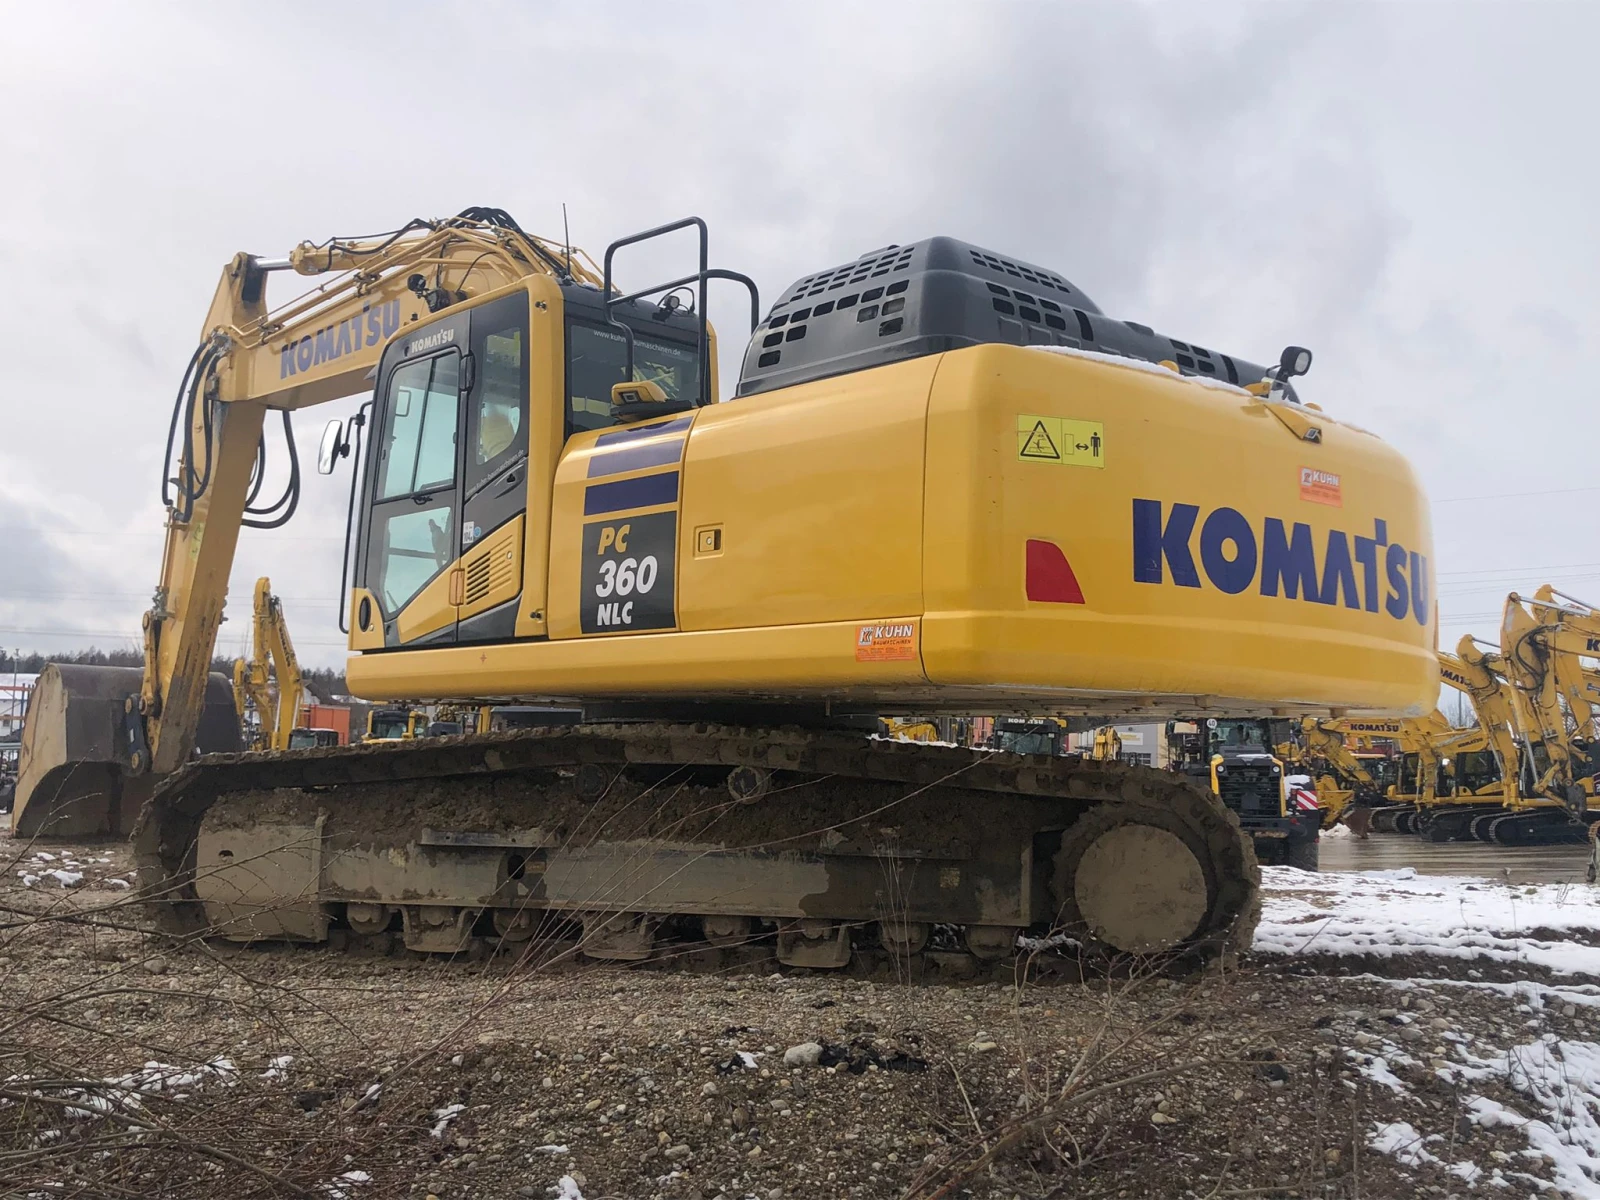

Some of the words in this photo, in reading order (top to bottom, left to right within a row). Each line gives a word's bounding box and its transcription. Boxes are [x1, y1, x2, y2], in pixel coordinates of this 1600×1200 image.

[280, 300, 401, 380] KOMATSU
[411, 328, 454, 354] KOMATSU
[1313, 470, 1340, 486] KUHN
[597, 524, 631, 555] PC
[1132, 498, 1427, 626] KOMATSU
[595, 555, 658, 597] 360
[597, 601, 633, 626] NLC
[874, 624, 913, 639] KUHN
[1350, 722, 1399, 732] KOMATSU
